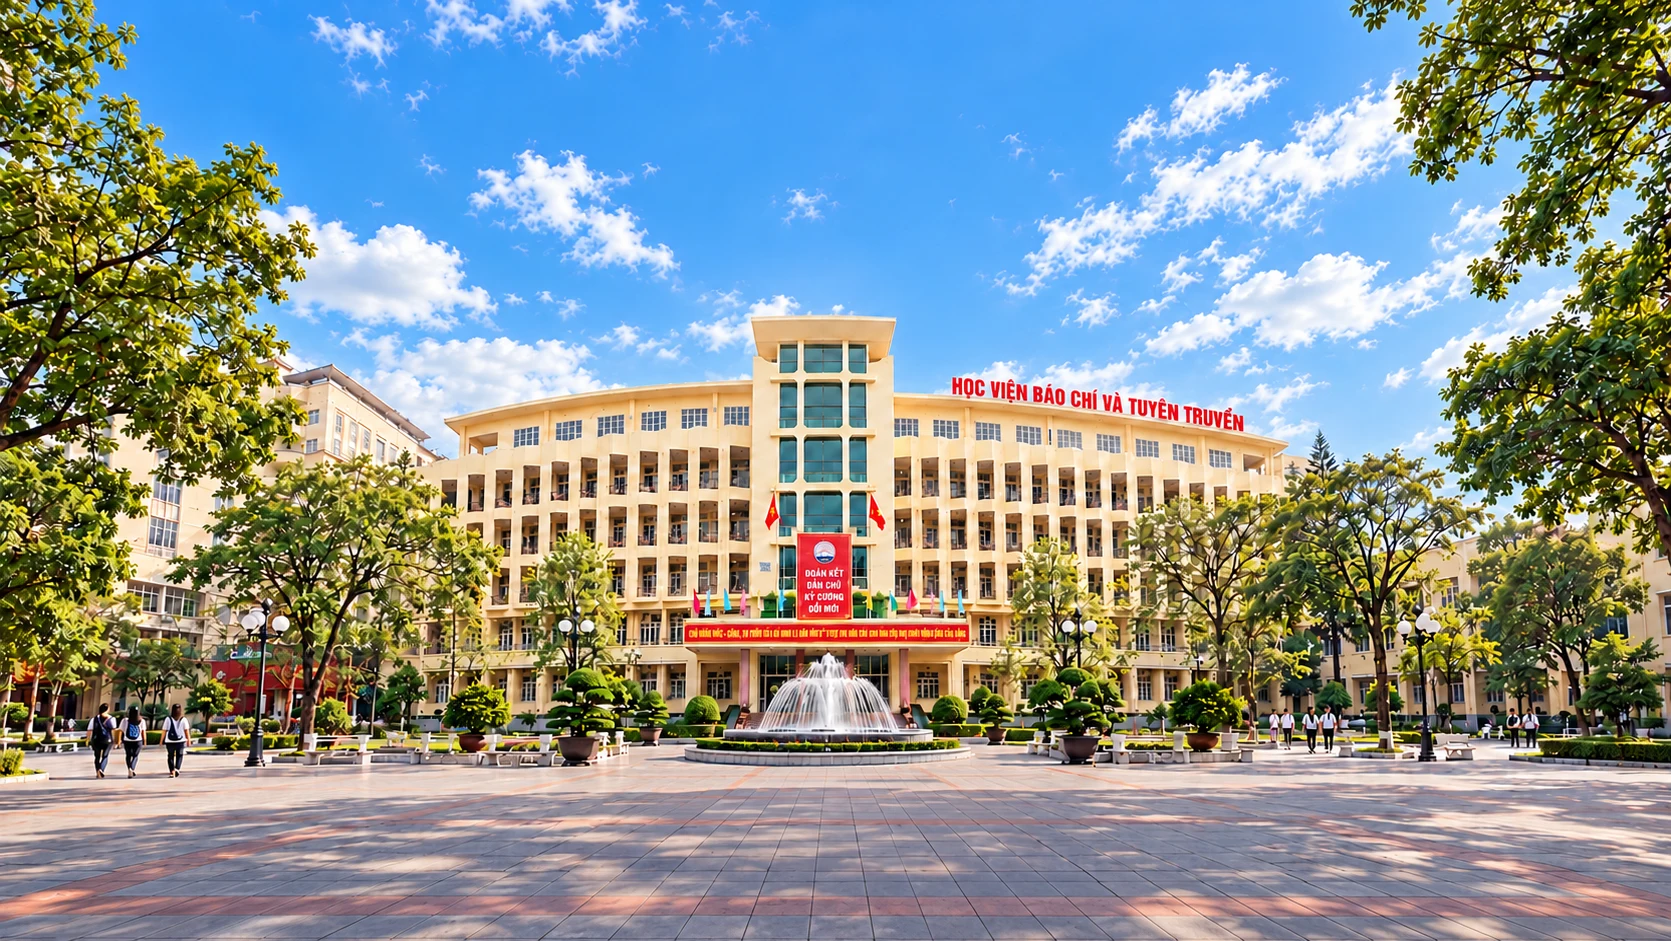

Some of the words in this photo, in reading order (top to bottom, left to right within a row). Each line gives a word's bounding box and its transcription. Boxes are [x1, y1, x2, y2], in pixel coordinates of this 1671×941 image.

[952, 377, 985, 399] HỌC
[990, 379, 1028, 403] VIỆN
[1032, 383, 1066, 406] BÁO
[1070, 389, 1098, 410] CHÍ
[1102, 391, 1123, 414] VÀ
[1128, 397, 1179, 422] TUYÊN
